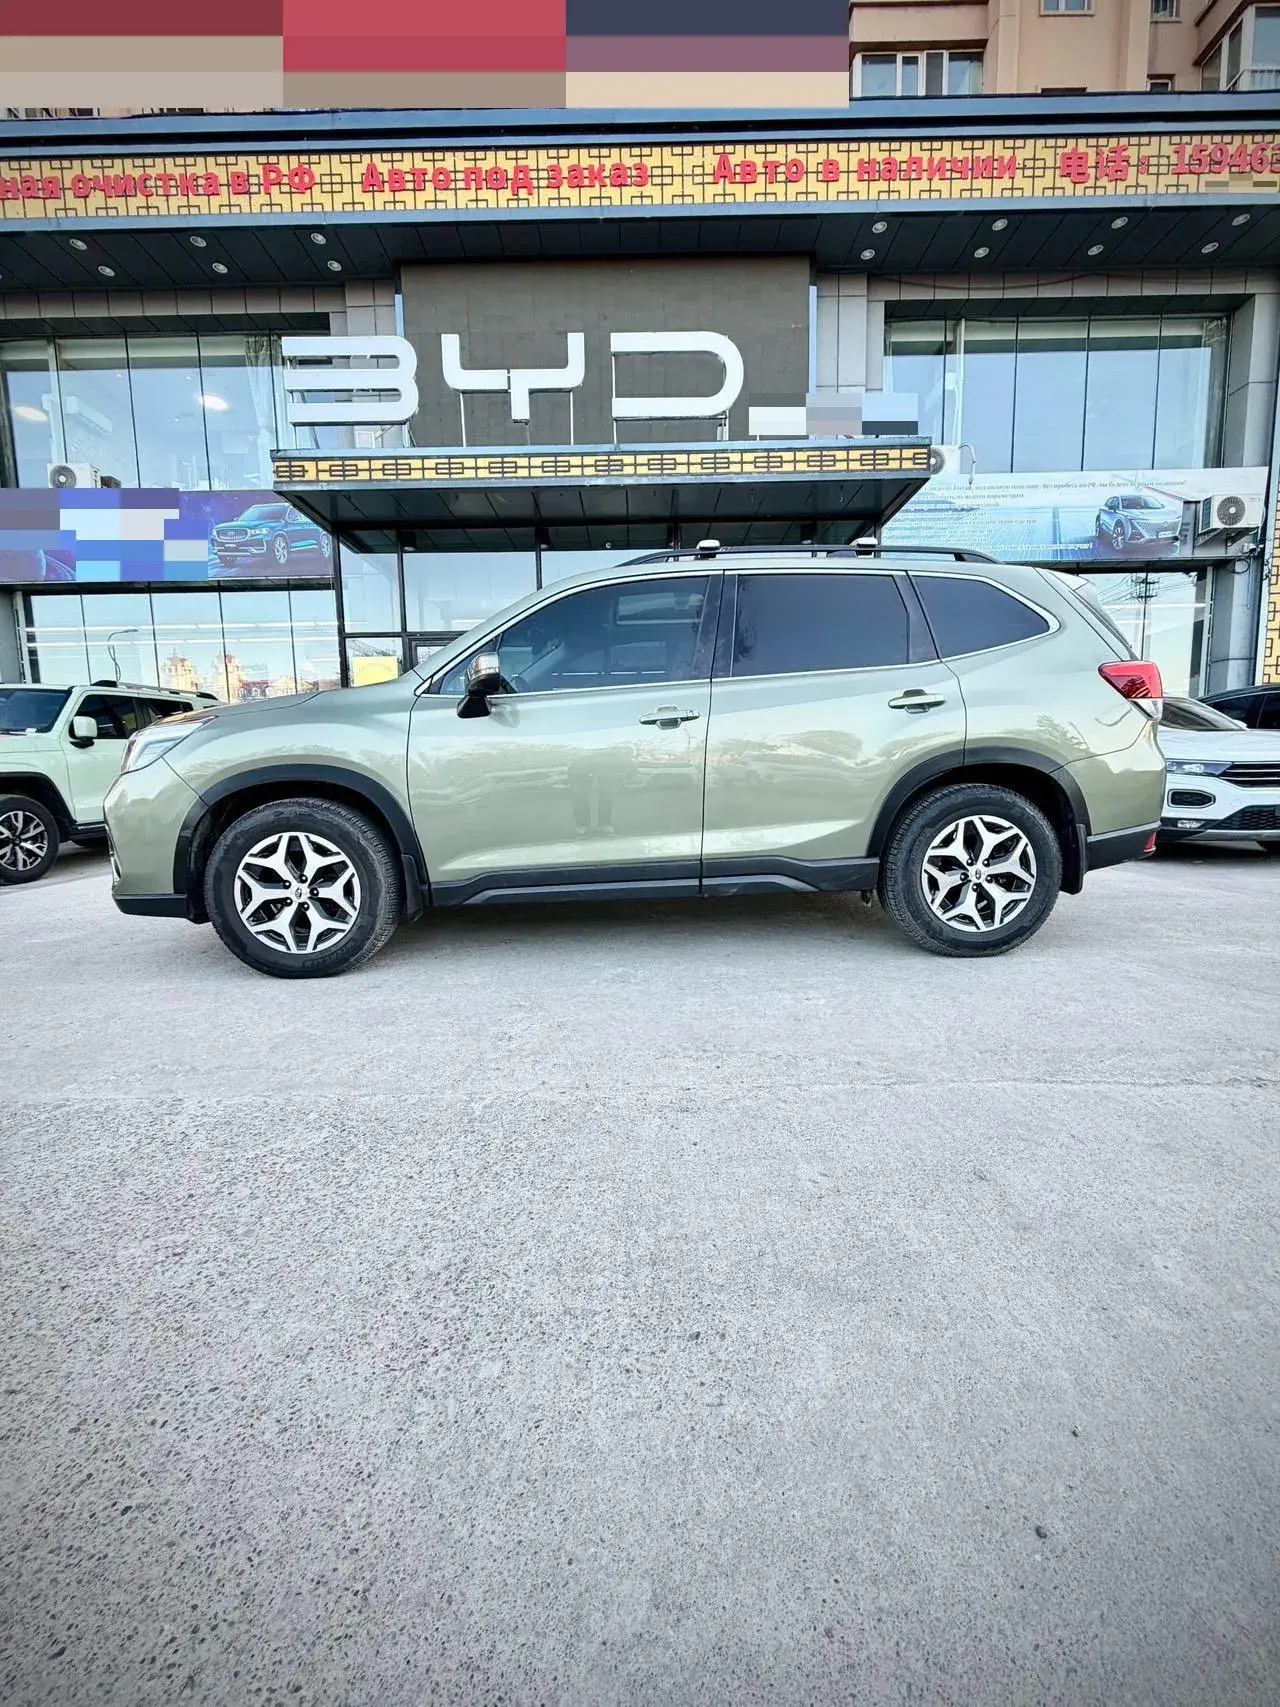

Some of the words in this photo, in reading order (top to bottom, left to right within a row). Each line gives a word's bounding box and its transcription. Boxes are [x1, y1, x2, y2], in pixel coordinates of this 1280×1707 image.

[71, 171, 221, 198] очистка
[230, 171, 249, 196] в
[262, 162, 317, 195] РФ
[361, 161, 453, 193] Авто
[463, 164, 535, 196] под
[546, 161, 650, 189] заказ
[712, 153, 806, 185] Авто
[821, 158, 841, 183] в
[856, 154, 1018, 183] наличии
[282, 330, 745, 425] BYD
